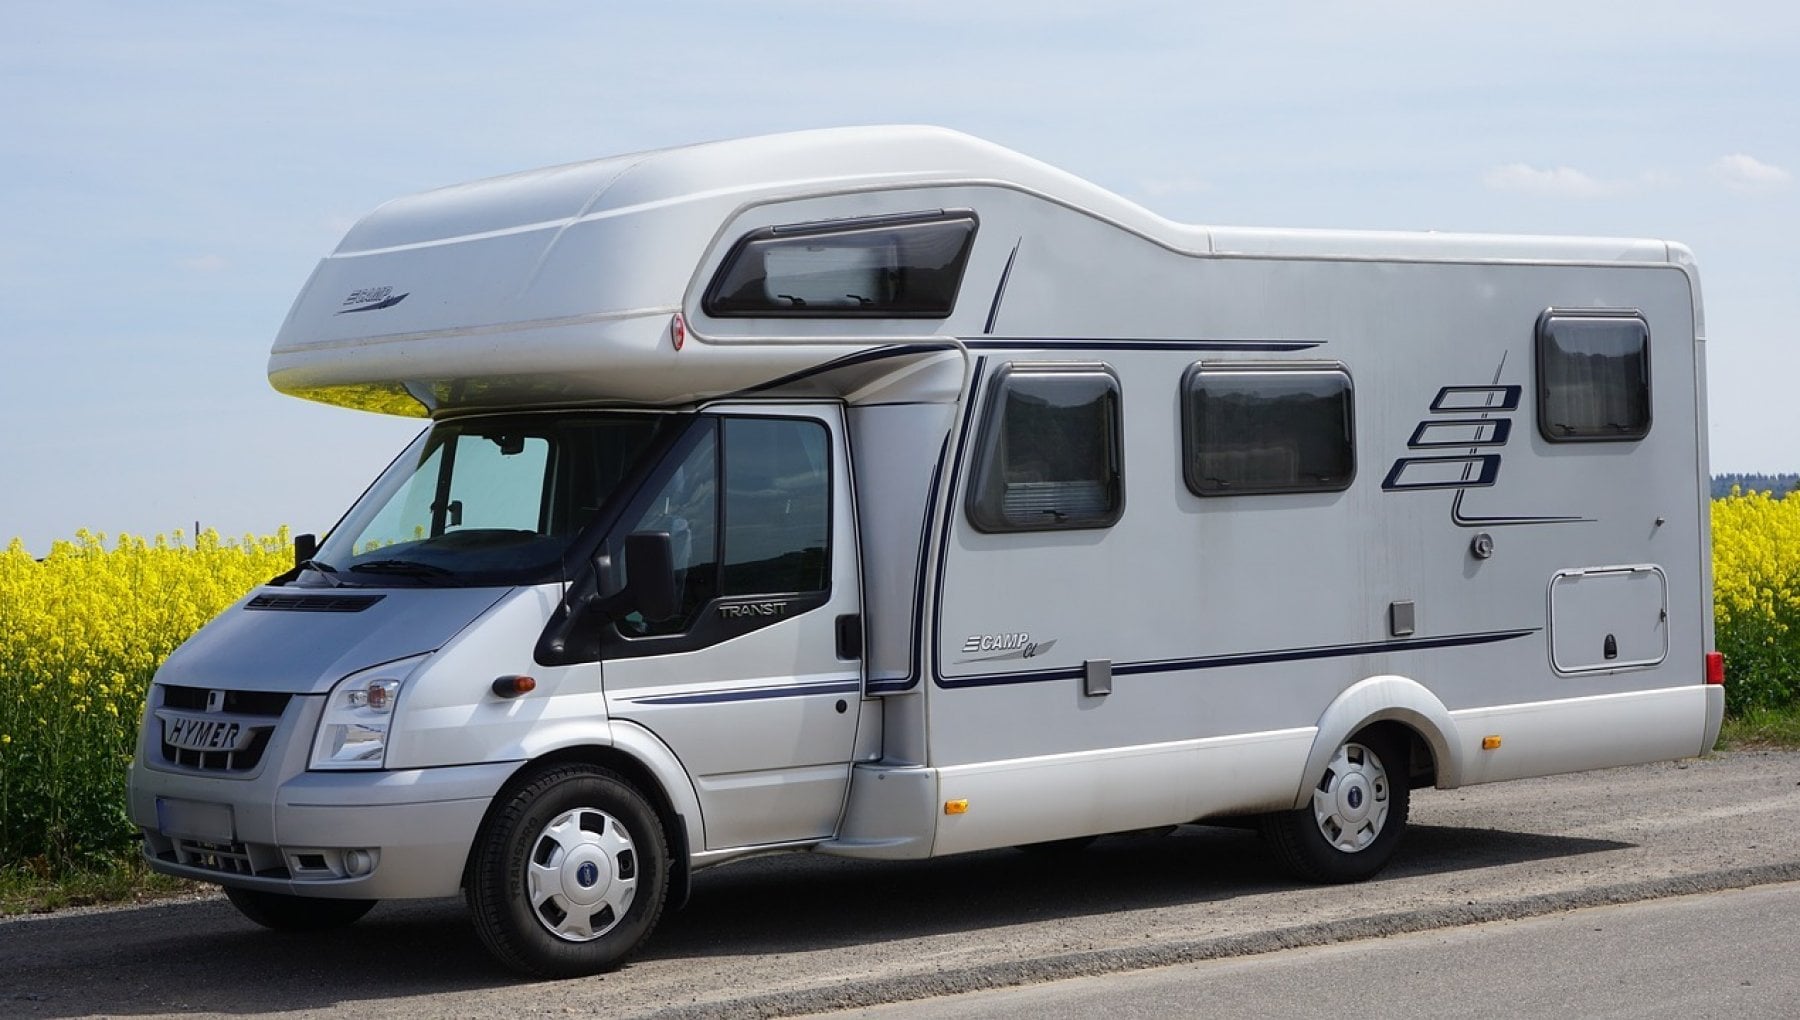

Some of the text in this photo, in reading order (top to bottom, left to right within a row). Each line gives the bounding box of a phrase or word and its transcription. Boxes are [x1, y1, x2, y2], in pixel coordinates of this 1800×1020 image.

[719, 602, 787, 618] TRANSIT
[169, 718, 240, 748] HYMER
[511, 817, 537, 900] TRANSPRO
